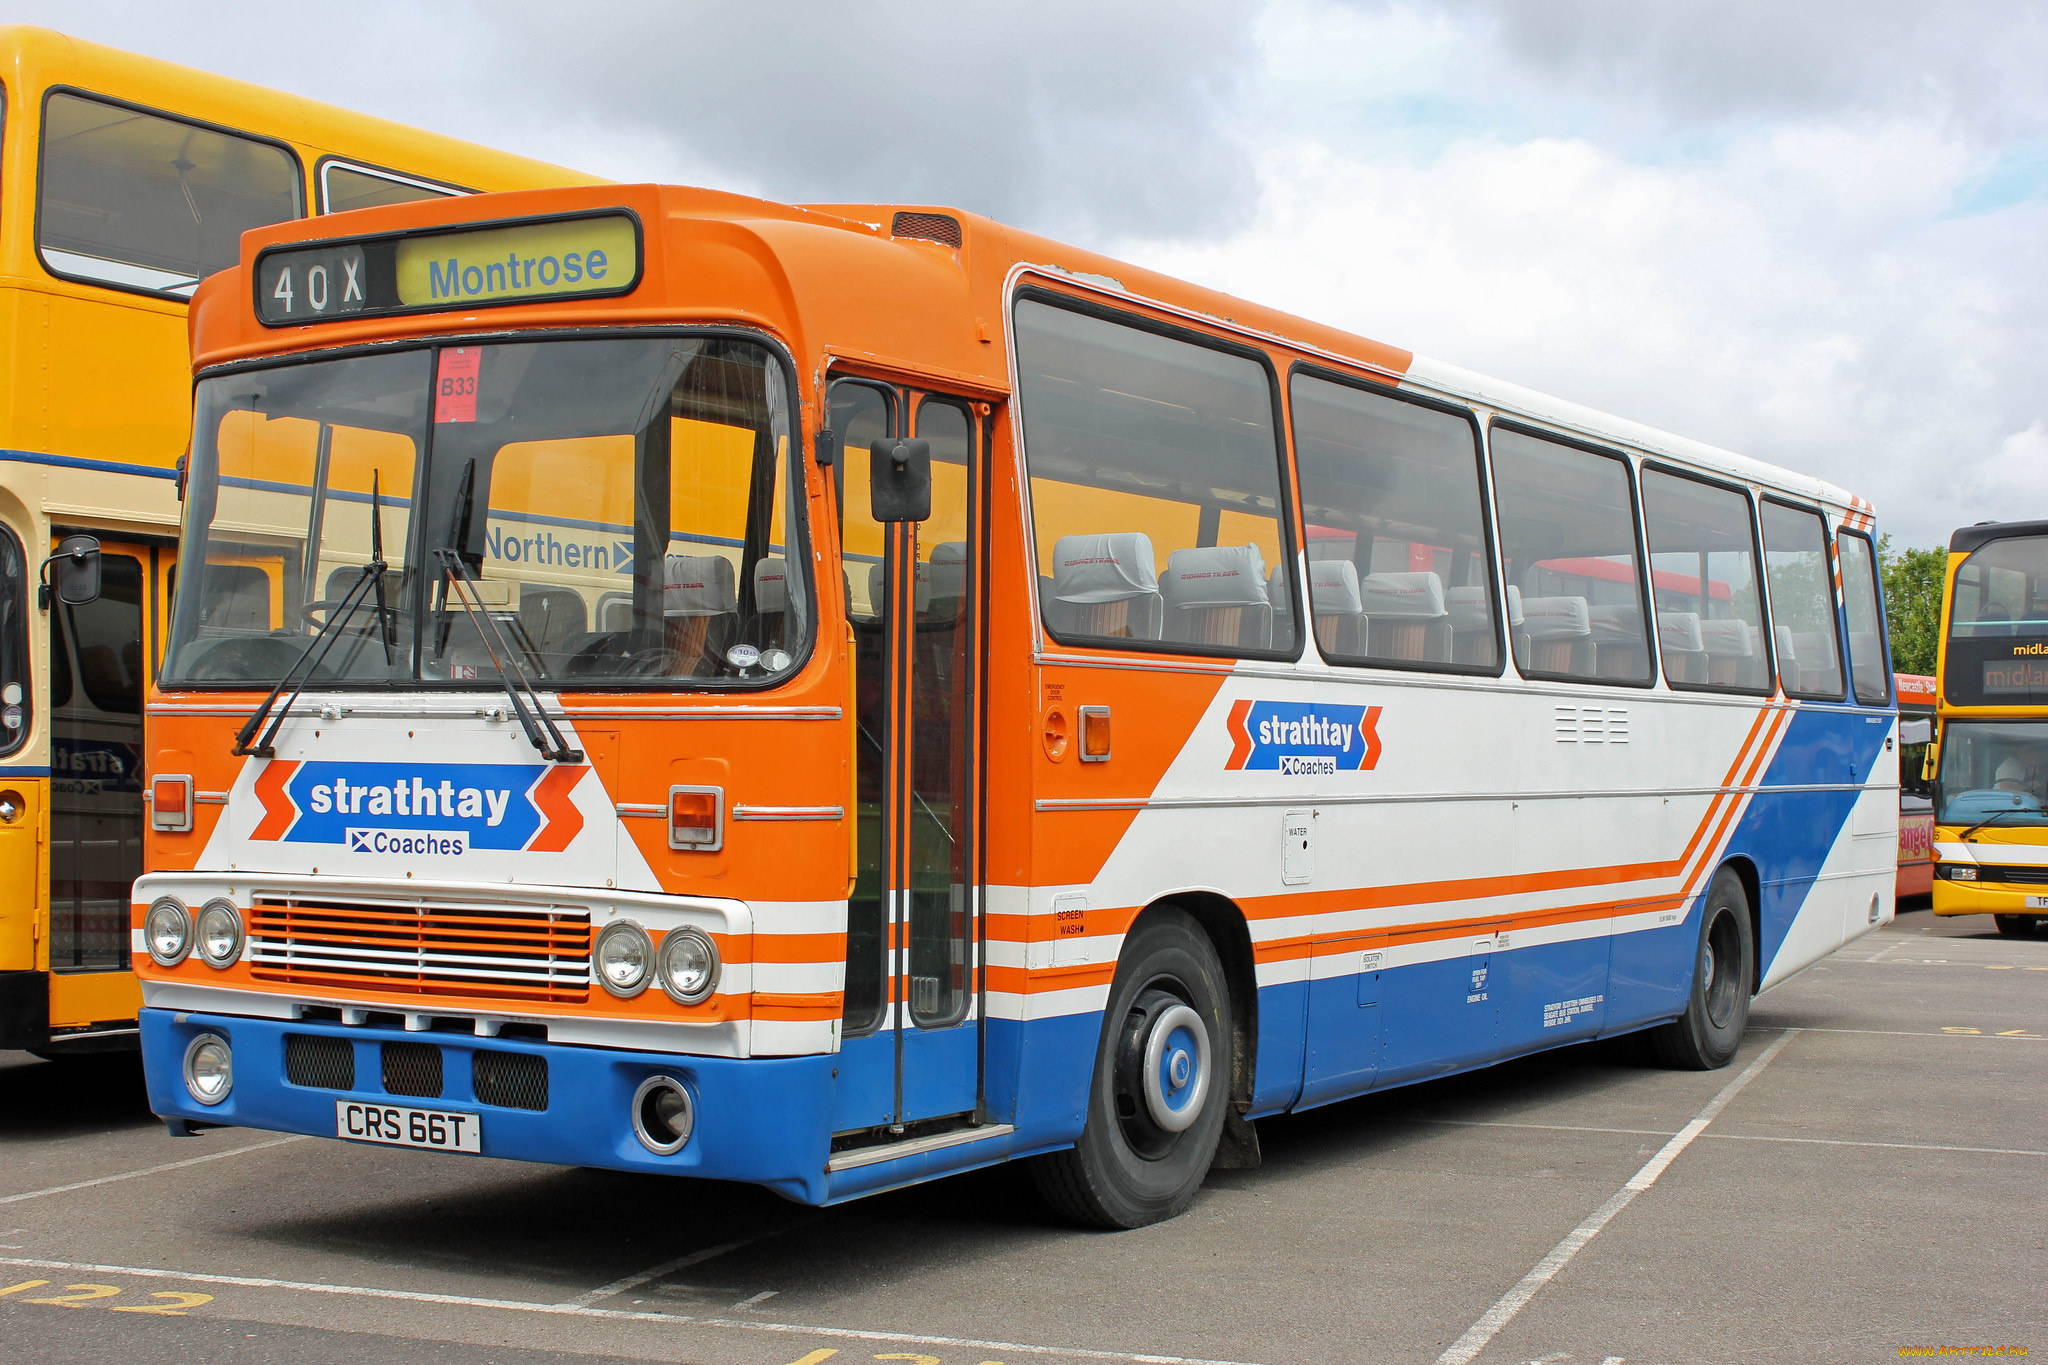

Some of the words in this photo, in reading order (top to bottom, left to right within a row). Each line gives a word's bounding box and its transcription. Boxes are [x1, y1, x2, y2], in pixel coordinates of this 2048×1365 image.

[429, 249, 608, 299] Montrose
[441, 376, 475, 396] B33
[483, 526, 610, 570] Northern
[1898, 678, 1924, 694] Newcastle
[1259, 714, 1353, 753] strathtay
[1293, 757, 1334, 775] Coaches
[311, 777, 511, 827] strathtay
[1289, 827, 1308, 837] WATER
[374, 831, 464, 855] Coaches
[1057, 909, 1084, 921] SCREEN
[1060, 924, 1080, 935] WASH
[1363, 954, 1380, 963] ISOLATOR
[1467, 994, 1481, 1004] ENGINE
[347, 1105, 402, 1140] CRS
[409, 1112, 466, 1147] 66T
